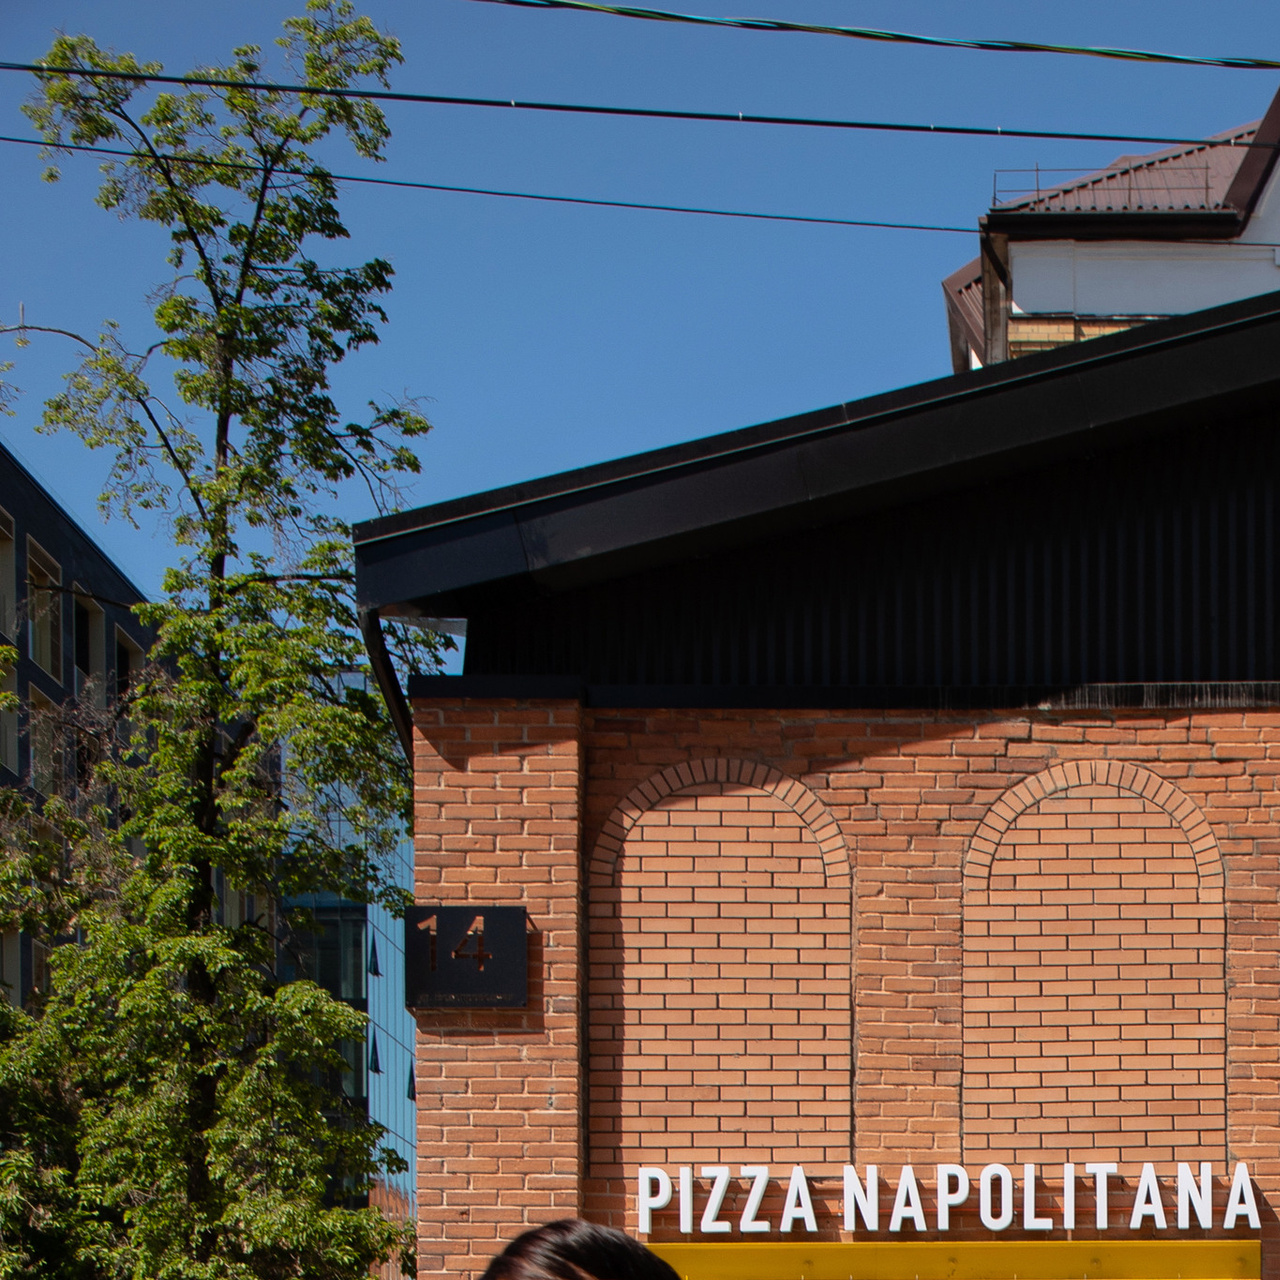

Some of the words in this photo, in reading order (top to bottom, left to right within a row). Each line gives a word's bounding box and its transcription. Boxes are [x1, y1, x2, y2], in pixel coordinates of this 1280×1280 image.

[416, 914, 493, 972] 14
[634, 1164, 818, 1234] PIZZA
[841, 1161, 1262, 1232] NAPOLITANA
